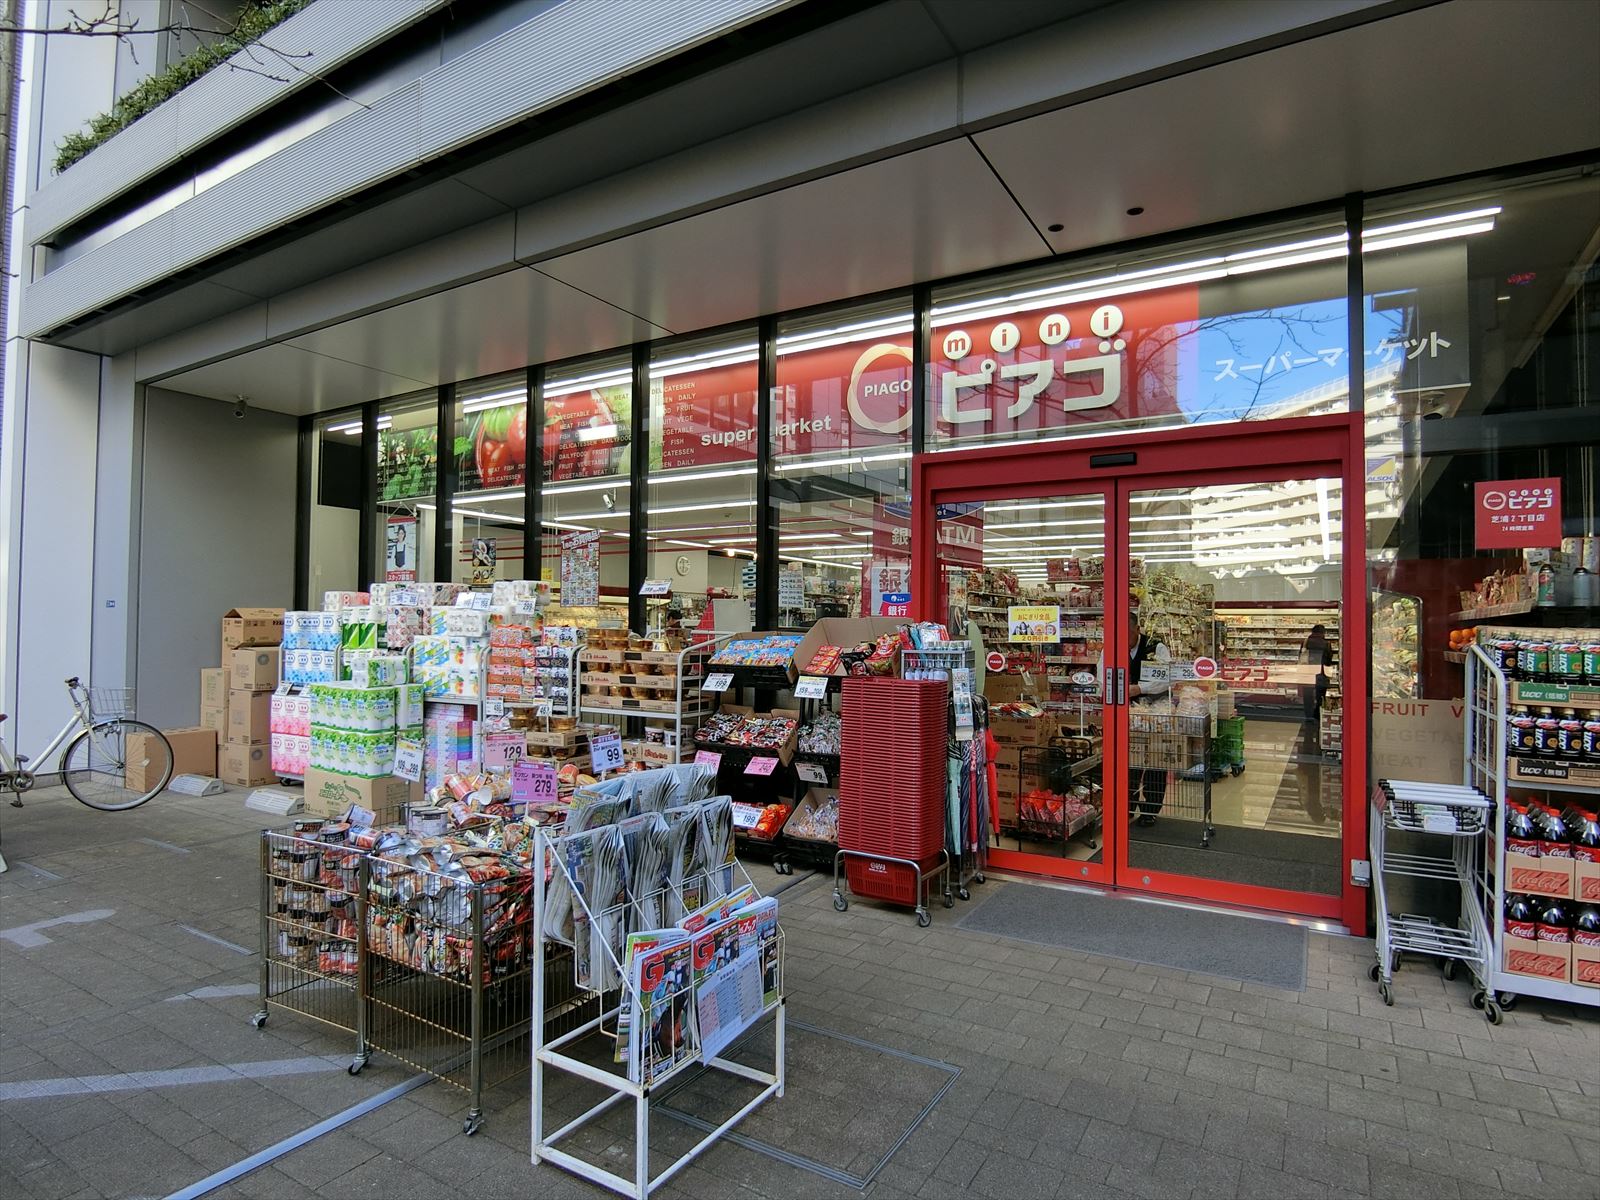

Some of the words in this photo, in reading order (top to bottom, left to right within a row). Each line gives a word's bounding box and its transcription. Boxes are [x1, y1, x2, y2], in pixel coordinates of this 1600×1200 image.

[864, 379, 912, 397] PIAGO
[941, 338, 1126, 424] ピアゴ
[663, 426, 694, 436] EGETABLE
[701, 428, 755, 447] super
[776, 415, 832, 437] arket
[1508, 495, 1553, 510] ピアゴ
[887, 605, 907, 617] 銀行
[1151, 669, 1167, 679] 299
[1370, 702, 1430, 717] FRUIT
[503, 745, 522, 759] 129
[607, 748, 620, 762] 99
[534, 779, 552, 794] 279
